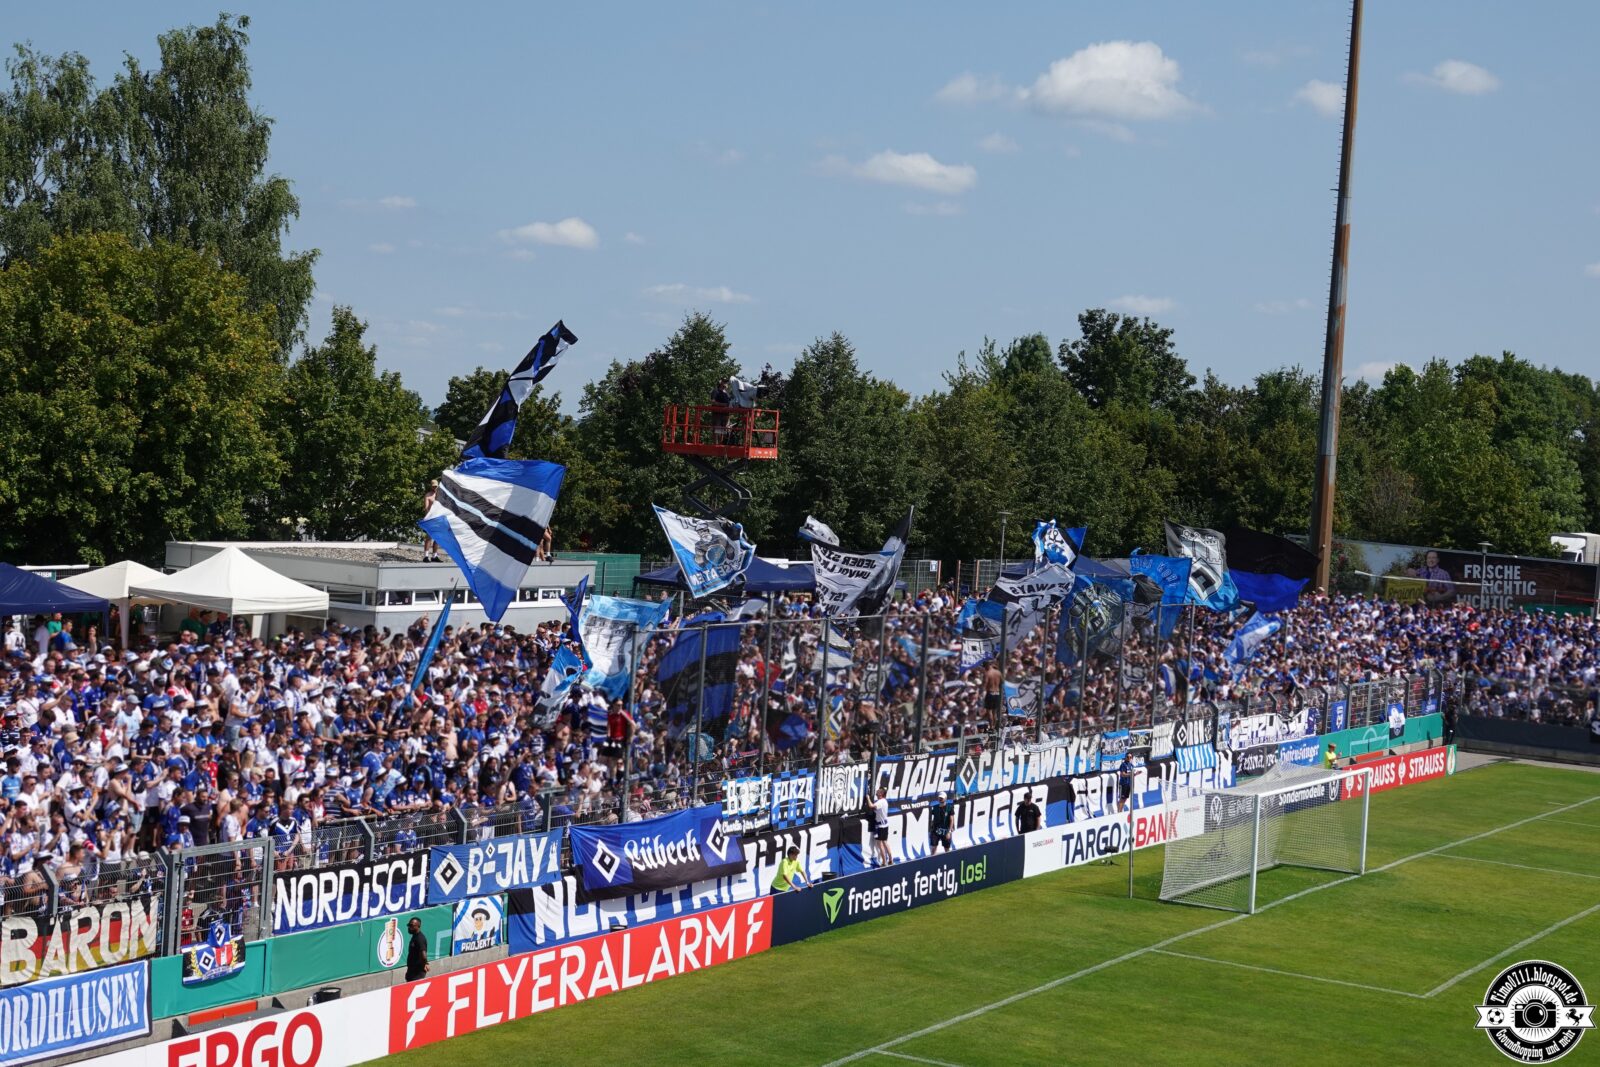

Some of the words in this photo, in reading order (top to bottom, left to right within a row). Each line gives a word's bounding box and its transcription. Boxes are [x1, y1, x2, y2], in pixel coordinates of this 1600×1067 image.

[1464, 564, 1521, 580] FRISCHE
[1482, 580, 1537, 596] RICHTIG
[1356, 762, 1396, 791] SRAUSS
[1409, 752, 1445, 780] STRAUSS
[772, 776, 815, 808] FORZA
[623, 828, 701, 872] Lübeck
[848, 877, 912, 916] freenet,
[914, 864, 958, 898] fertig,
[447, 907, 736, 1037] FLYERALARM
